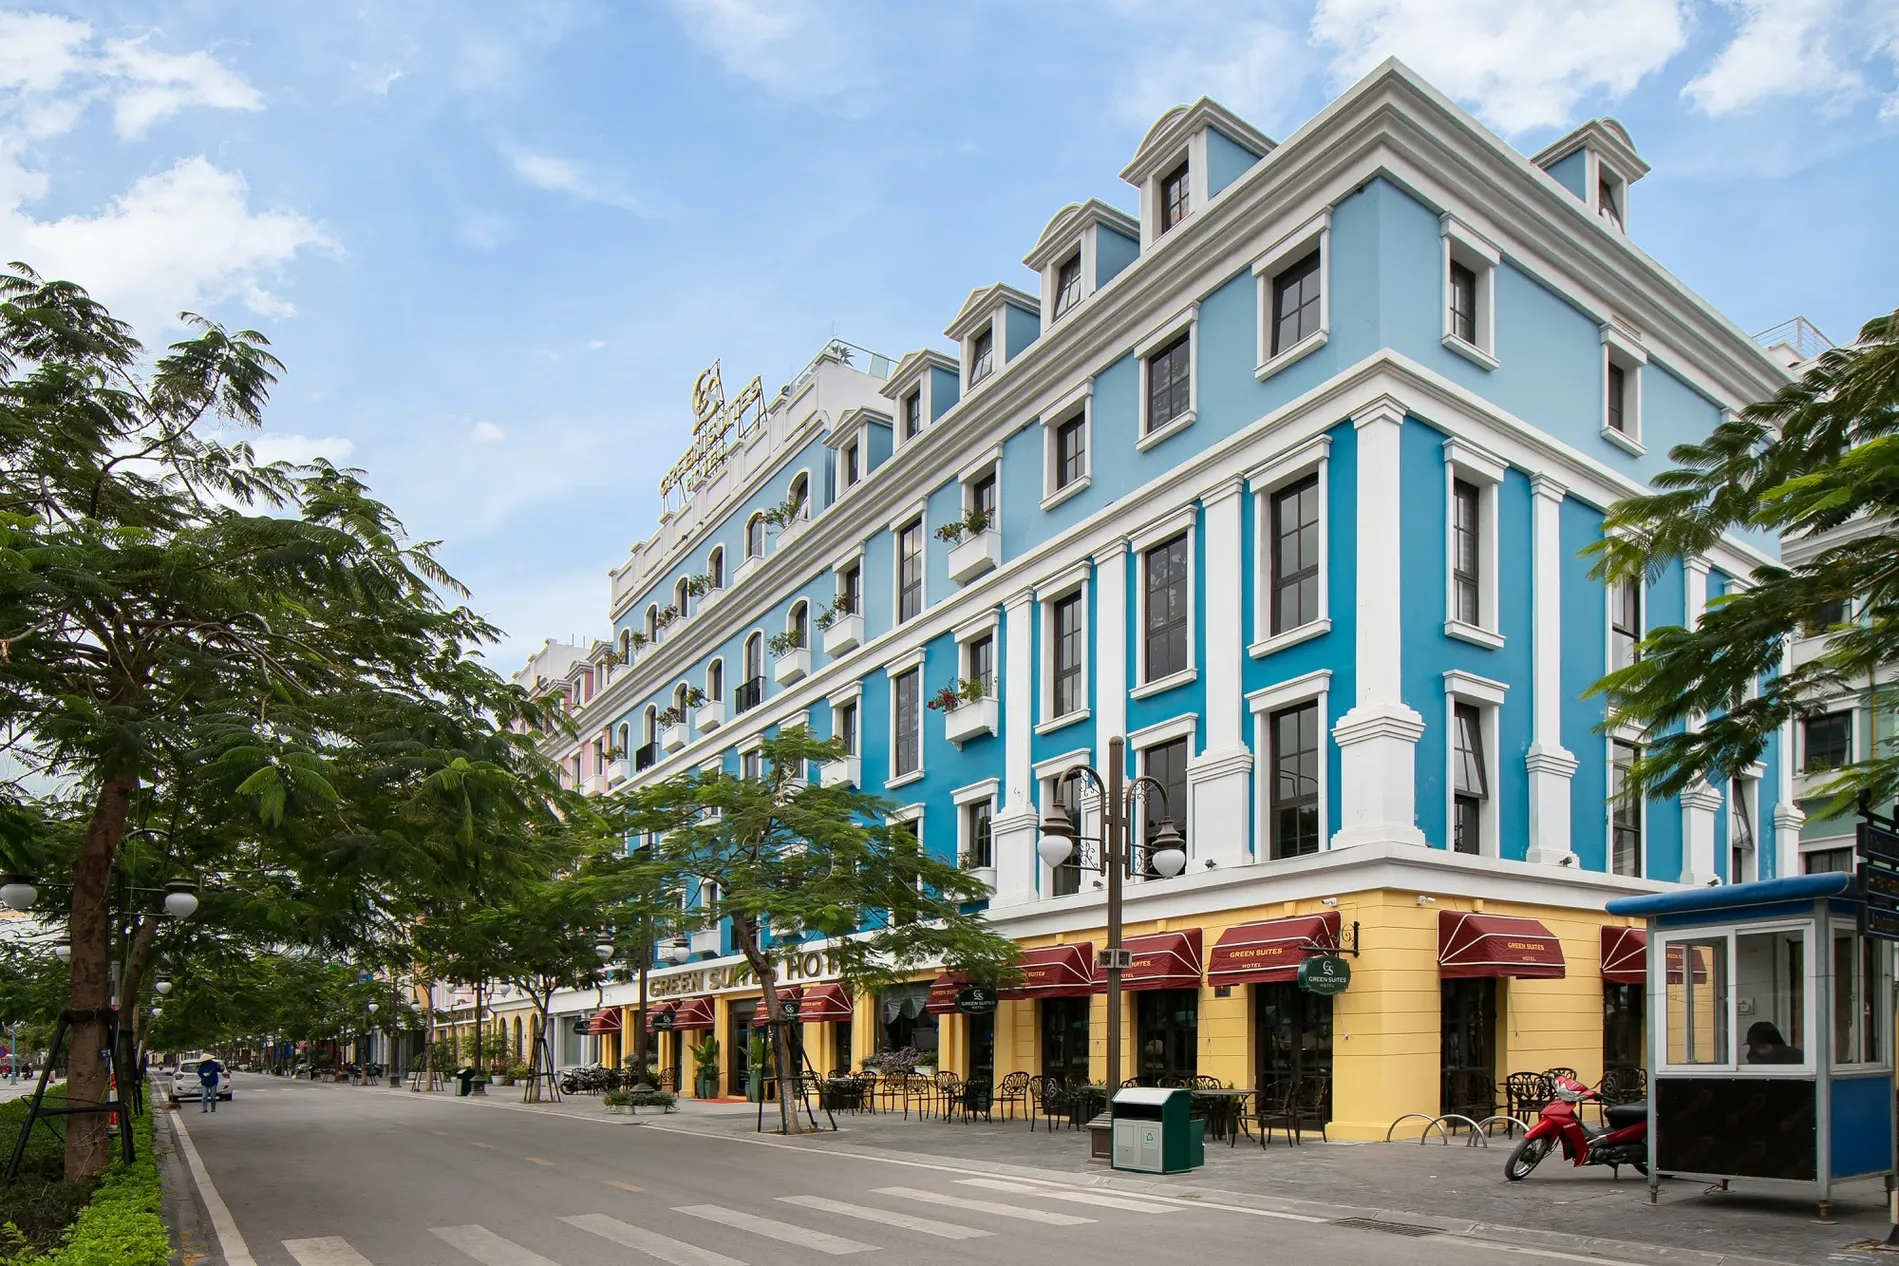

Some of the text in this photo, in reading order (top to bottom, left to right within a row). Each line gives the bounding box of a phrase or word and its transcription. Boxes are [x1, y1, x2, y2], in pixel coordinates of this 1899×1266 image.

[1507, 942, 1545, 951] GREEN SUITES
[1256, 947, 1283, 956] SUITES
[649, 971, 703, 997] GREEN
